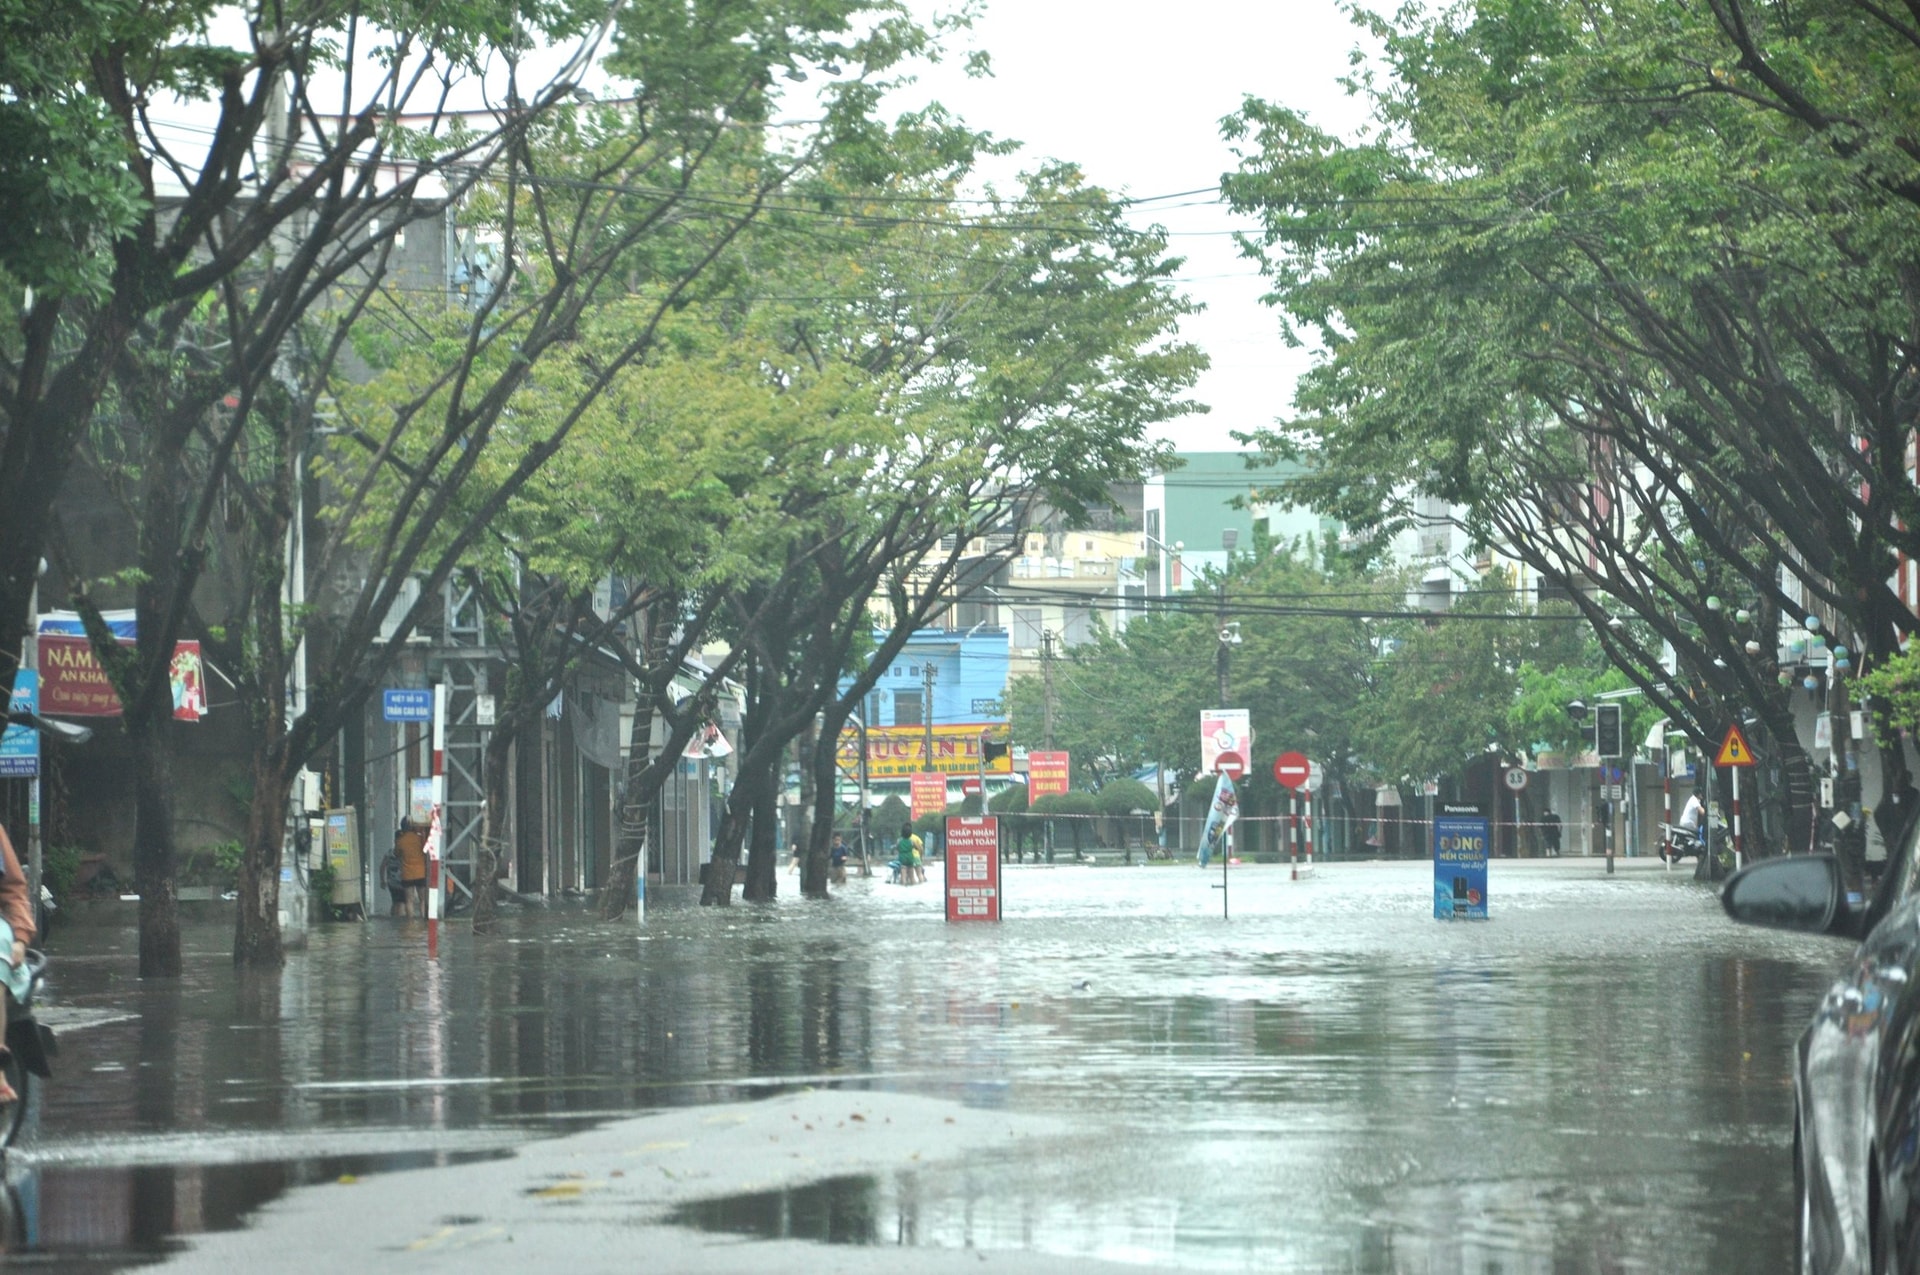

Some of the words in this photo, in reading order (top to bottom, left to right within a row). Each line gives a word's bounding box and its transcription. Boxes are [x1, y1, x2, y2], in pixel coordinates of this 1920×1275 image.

[47, 646, 92, 668] NĂM
[60, 670, 77, 681] AN
[1510, 772, 1523, 785] 3.5
[1444, 804, 1479, 813] Panasonic
[949, 826, 972, 837] CHẤP
[972, 827, 995, 838] NHẬN
[948, 838, 974, 846] THANH
